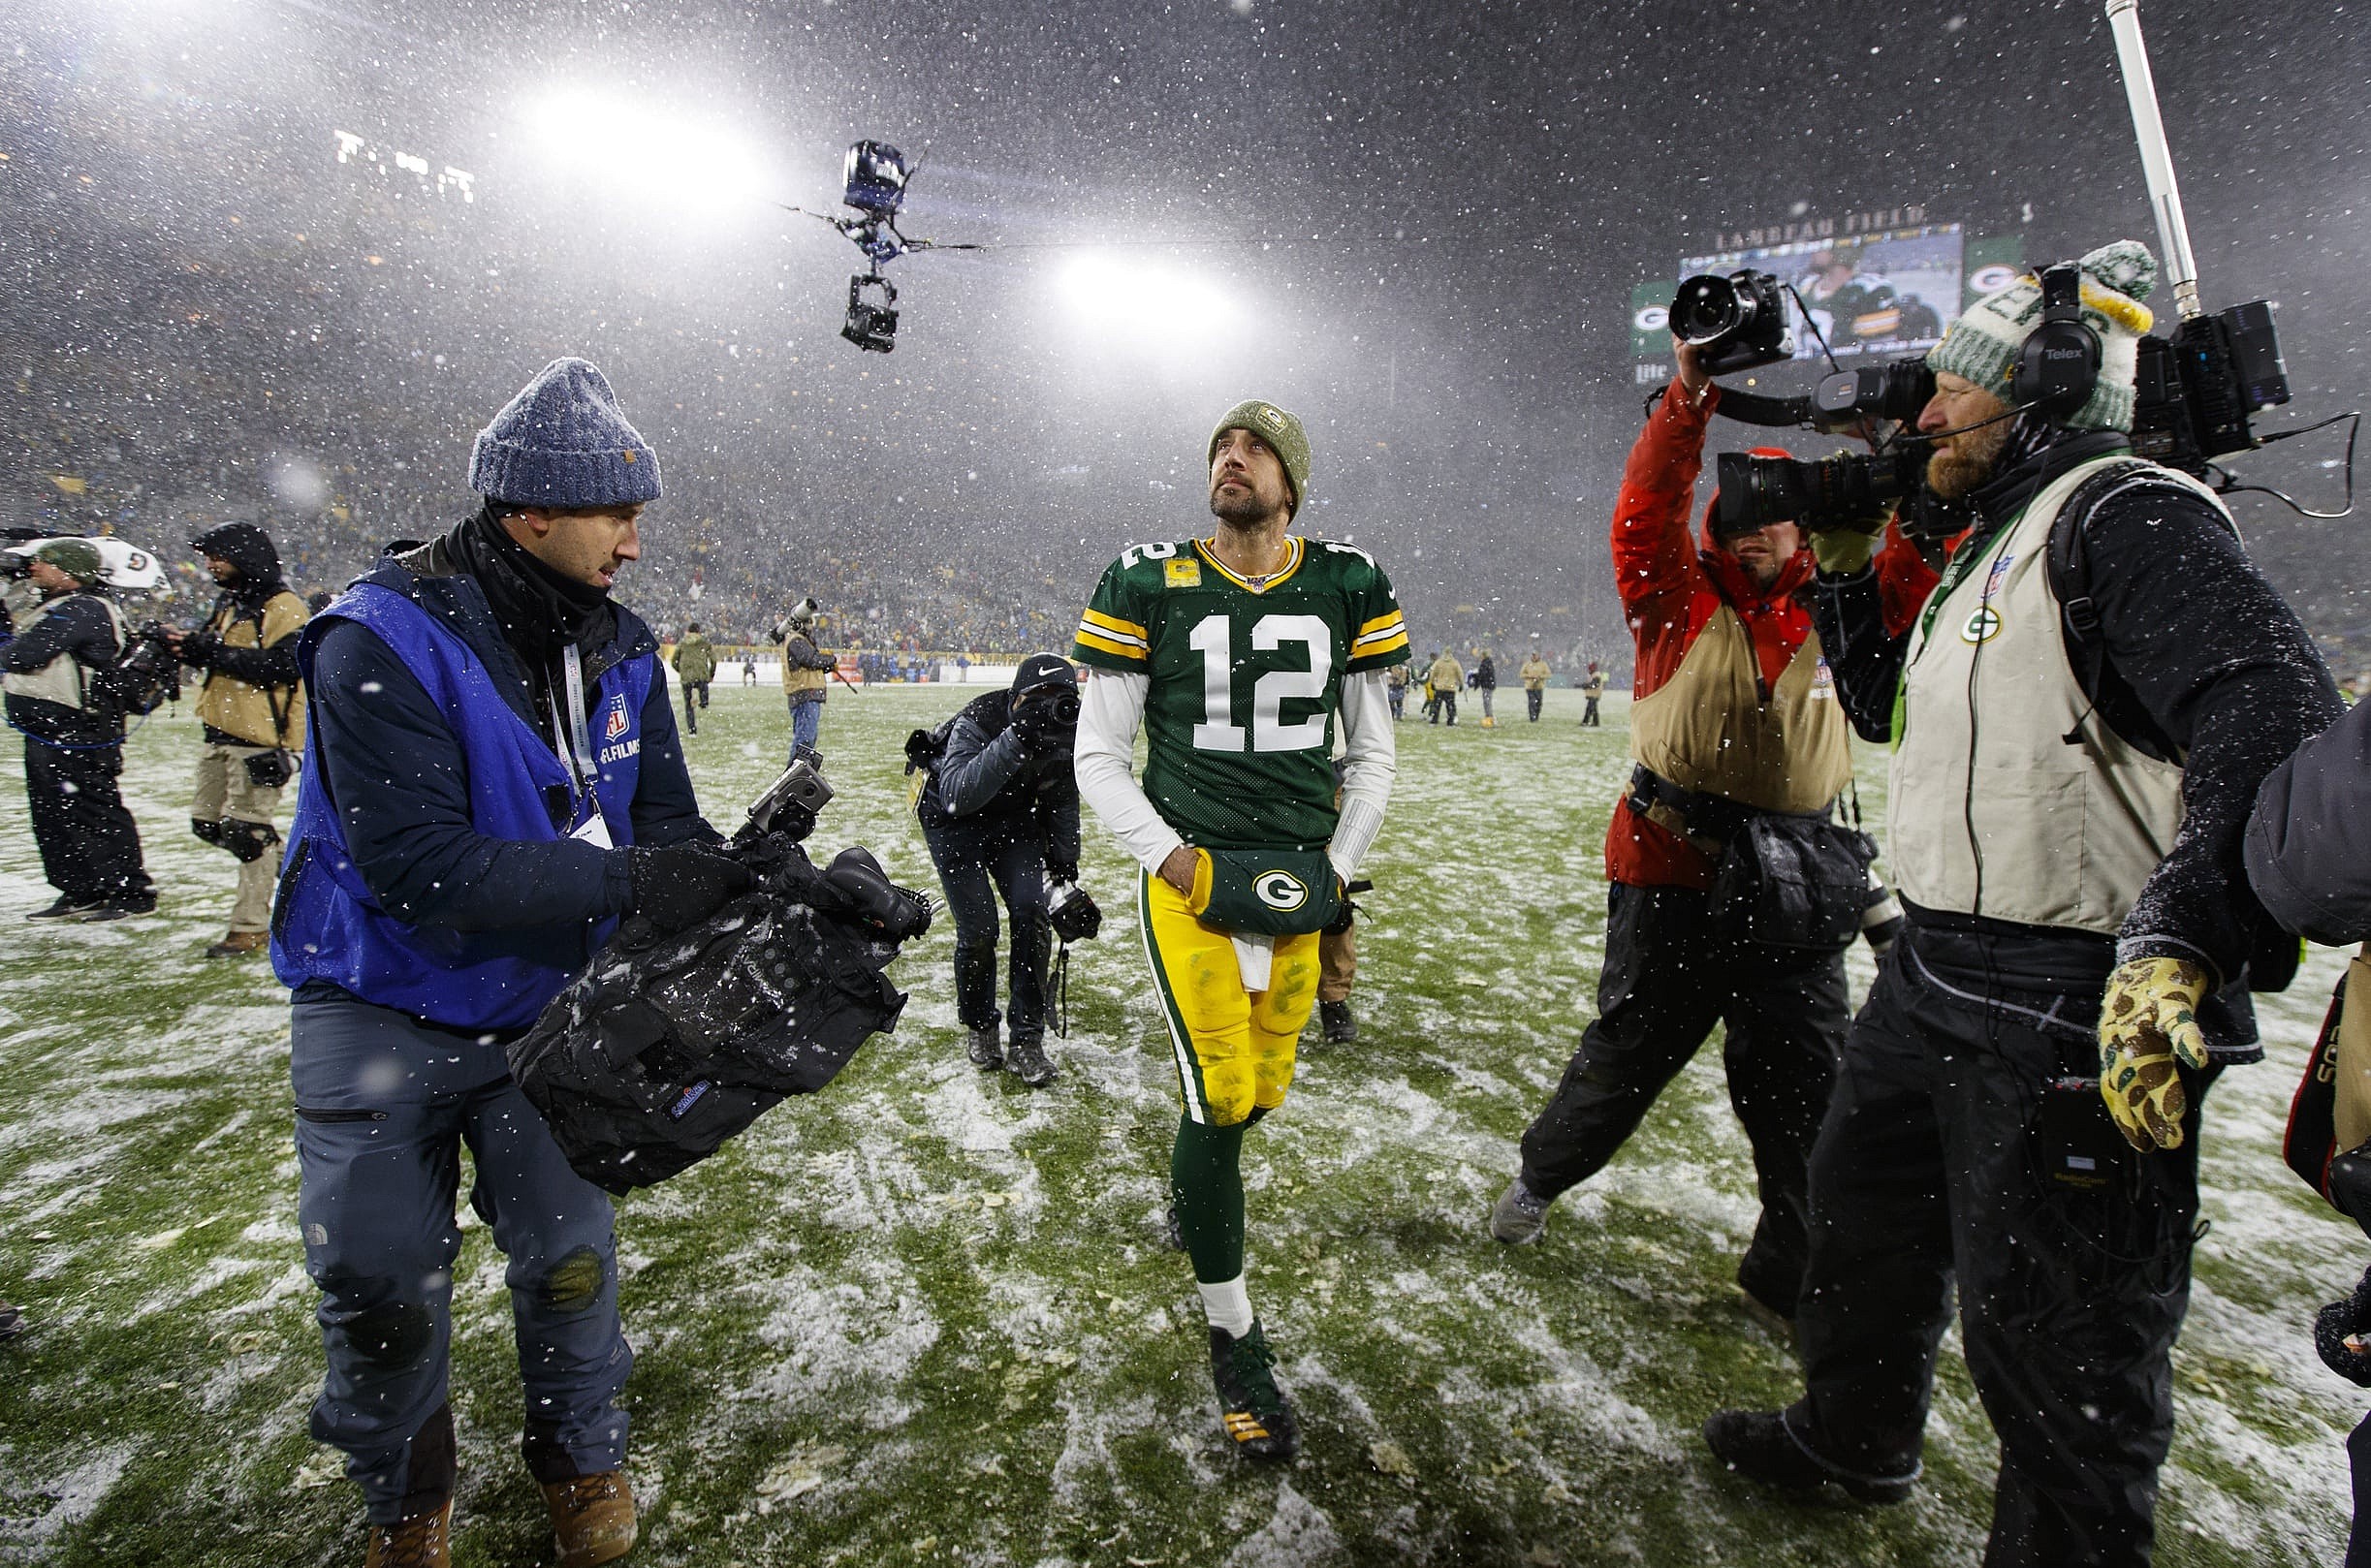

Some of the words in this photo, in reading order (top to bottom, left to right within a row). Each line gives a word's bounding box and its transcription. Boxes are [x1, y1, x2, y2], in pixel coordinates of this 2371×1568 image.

[1716, 218, 1834, 250] LAMBEAU
[2045, 348, 2083, 361] Telex
[1635, 363, 1668, 385] Lite
[1189, 614, 1331, 752] 12
[1253, 870, 1309, 912] G
